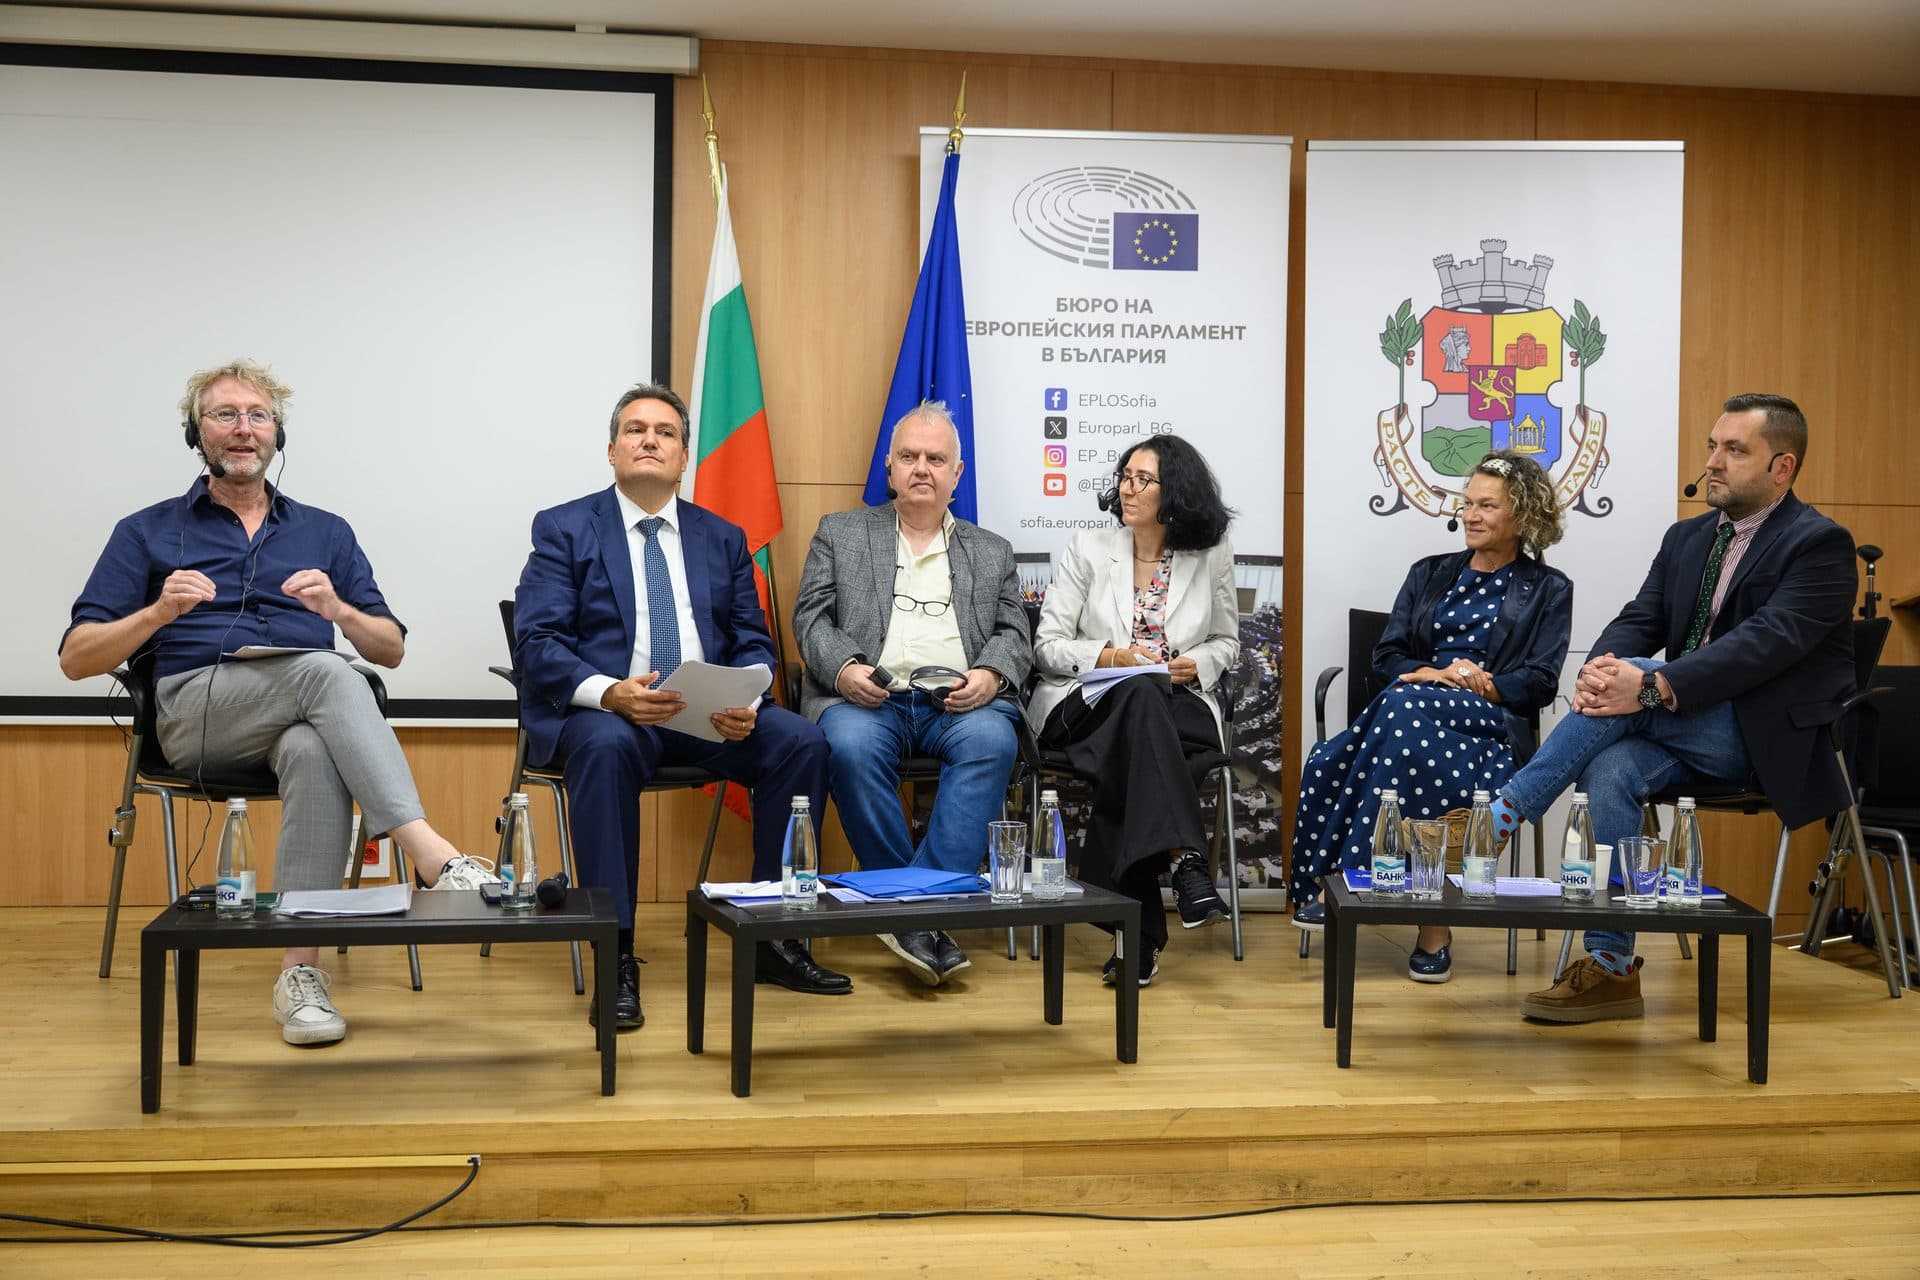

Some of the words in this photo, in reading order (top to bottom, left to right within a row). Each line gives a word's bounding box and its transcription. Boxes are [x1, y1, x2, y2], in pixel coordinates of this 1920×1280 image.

[1056, 297, 1118, 314] БЮРО
[1125, 299, 1153, 314] НА
[1121, 323, 1247, 340] ПАРЛАМЕНТ
[1042, 347, 1055, 362] В
[1061, 348, 1166, 364] БЪЛГАРИЯ
[1079, 393, 1157, 408] EPLOSofia
[1078, 421, 1173, 437] Europarl_BG
[1020, 516, 1123, 530] sofia.europarl
